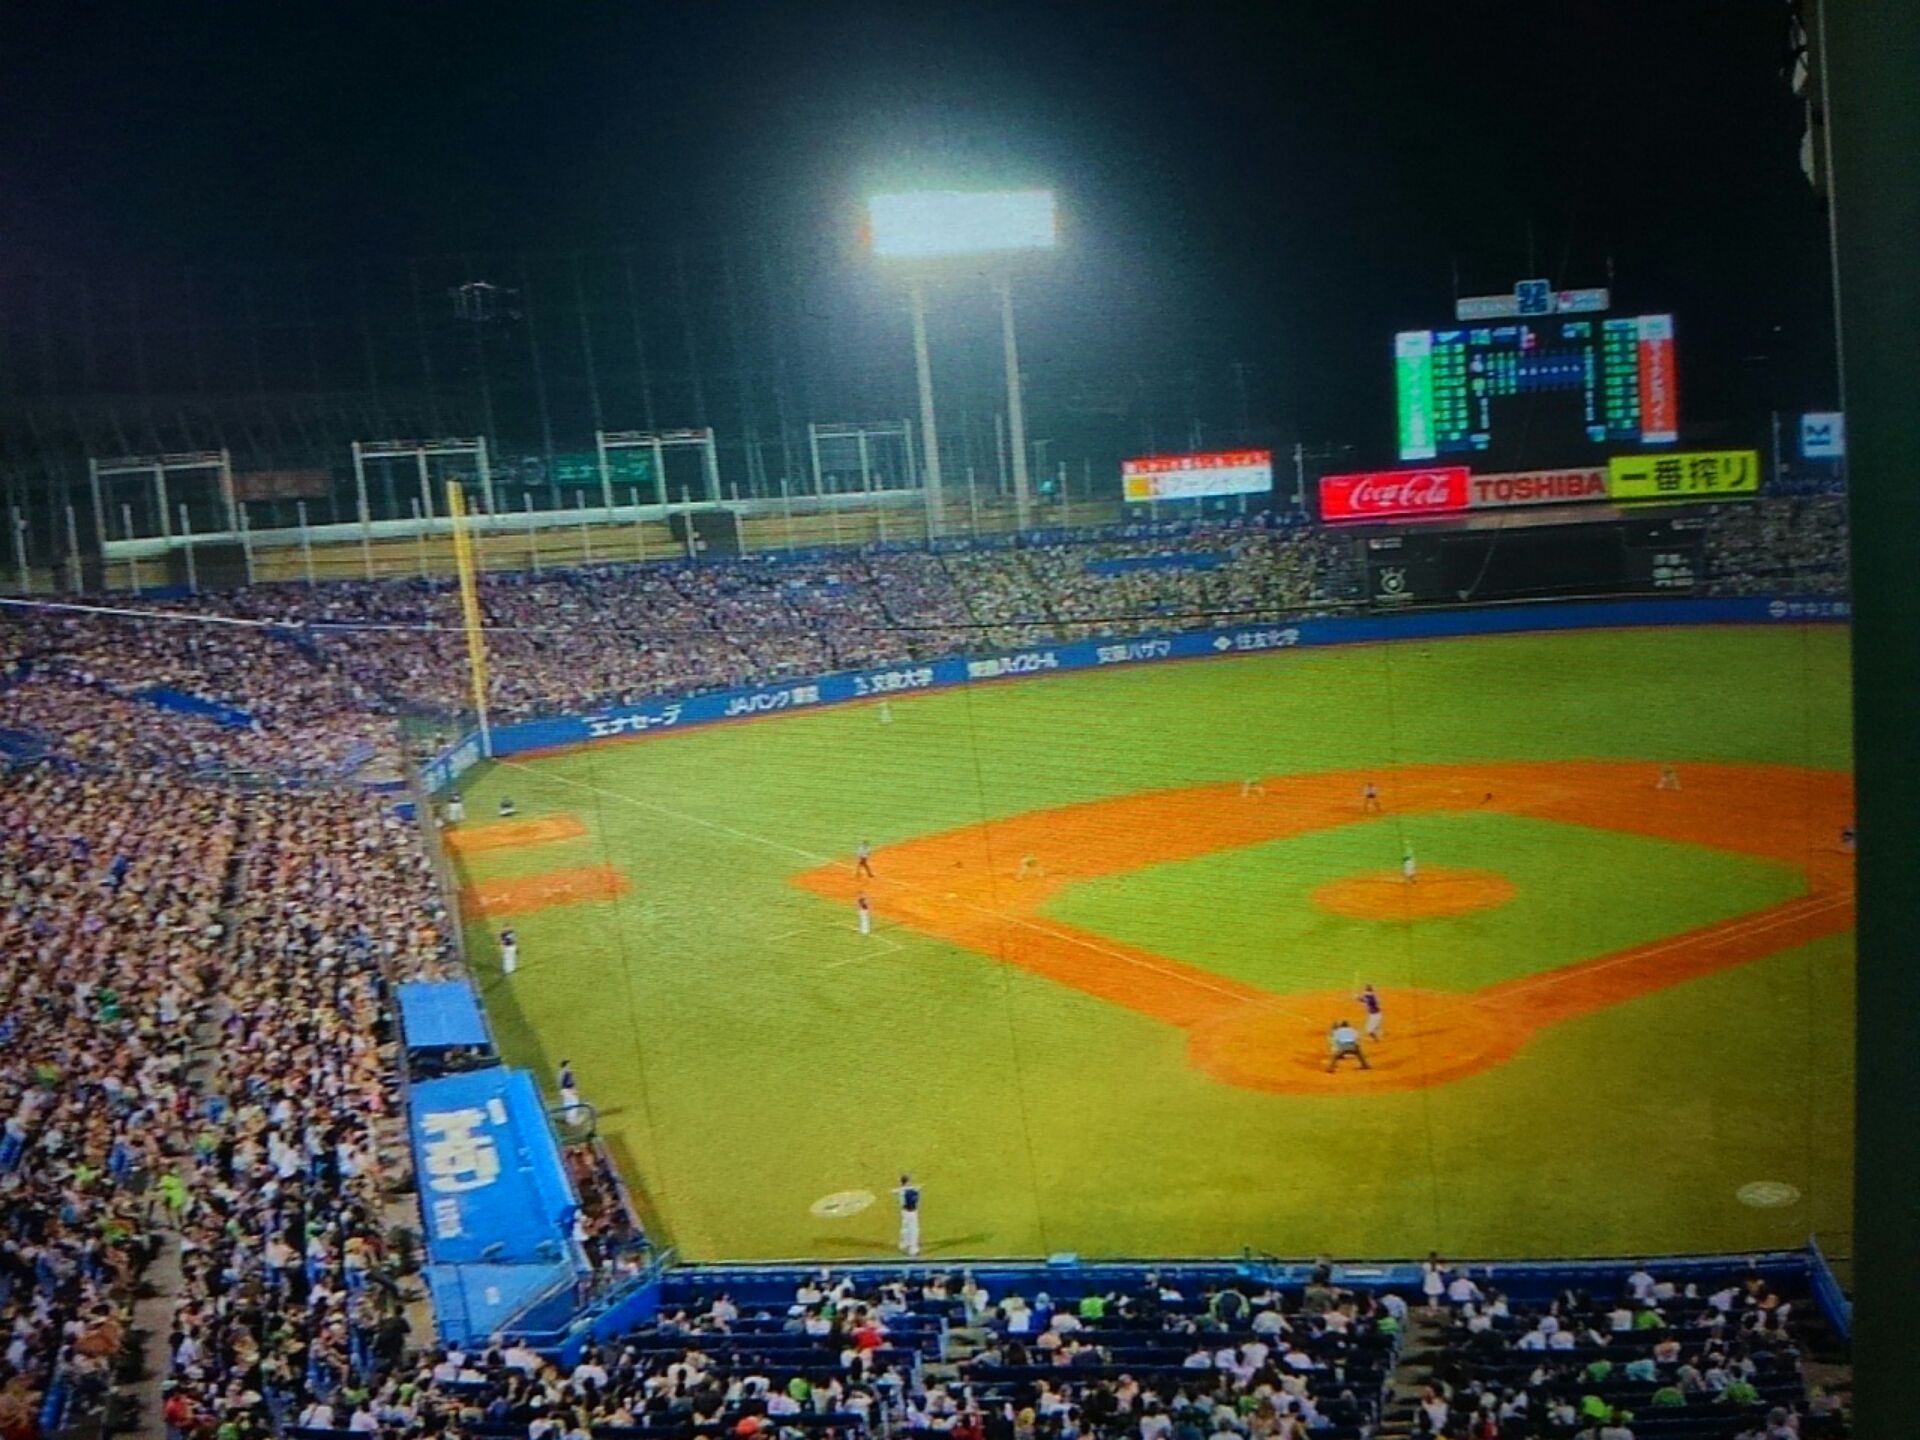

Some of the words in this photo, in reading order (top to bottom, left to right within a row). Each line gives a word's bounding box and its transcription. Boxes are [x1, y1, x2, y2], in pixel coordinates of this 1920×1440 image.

[1474, 473, 1605, 501] TOSHIBA
[1620, 456, 1748, 491] 一番搾り
